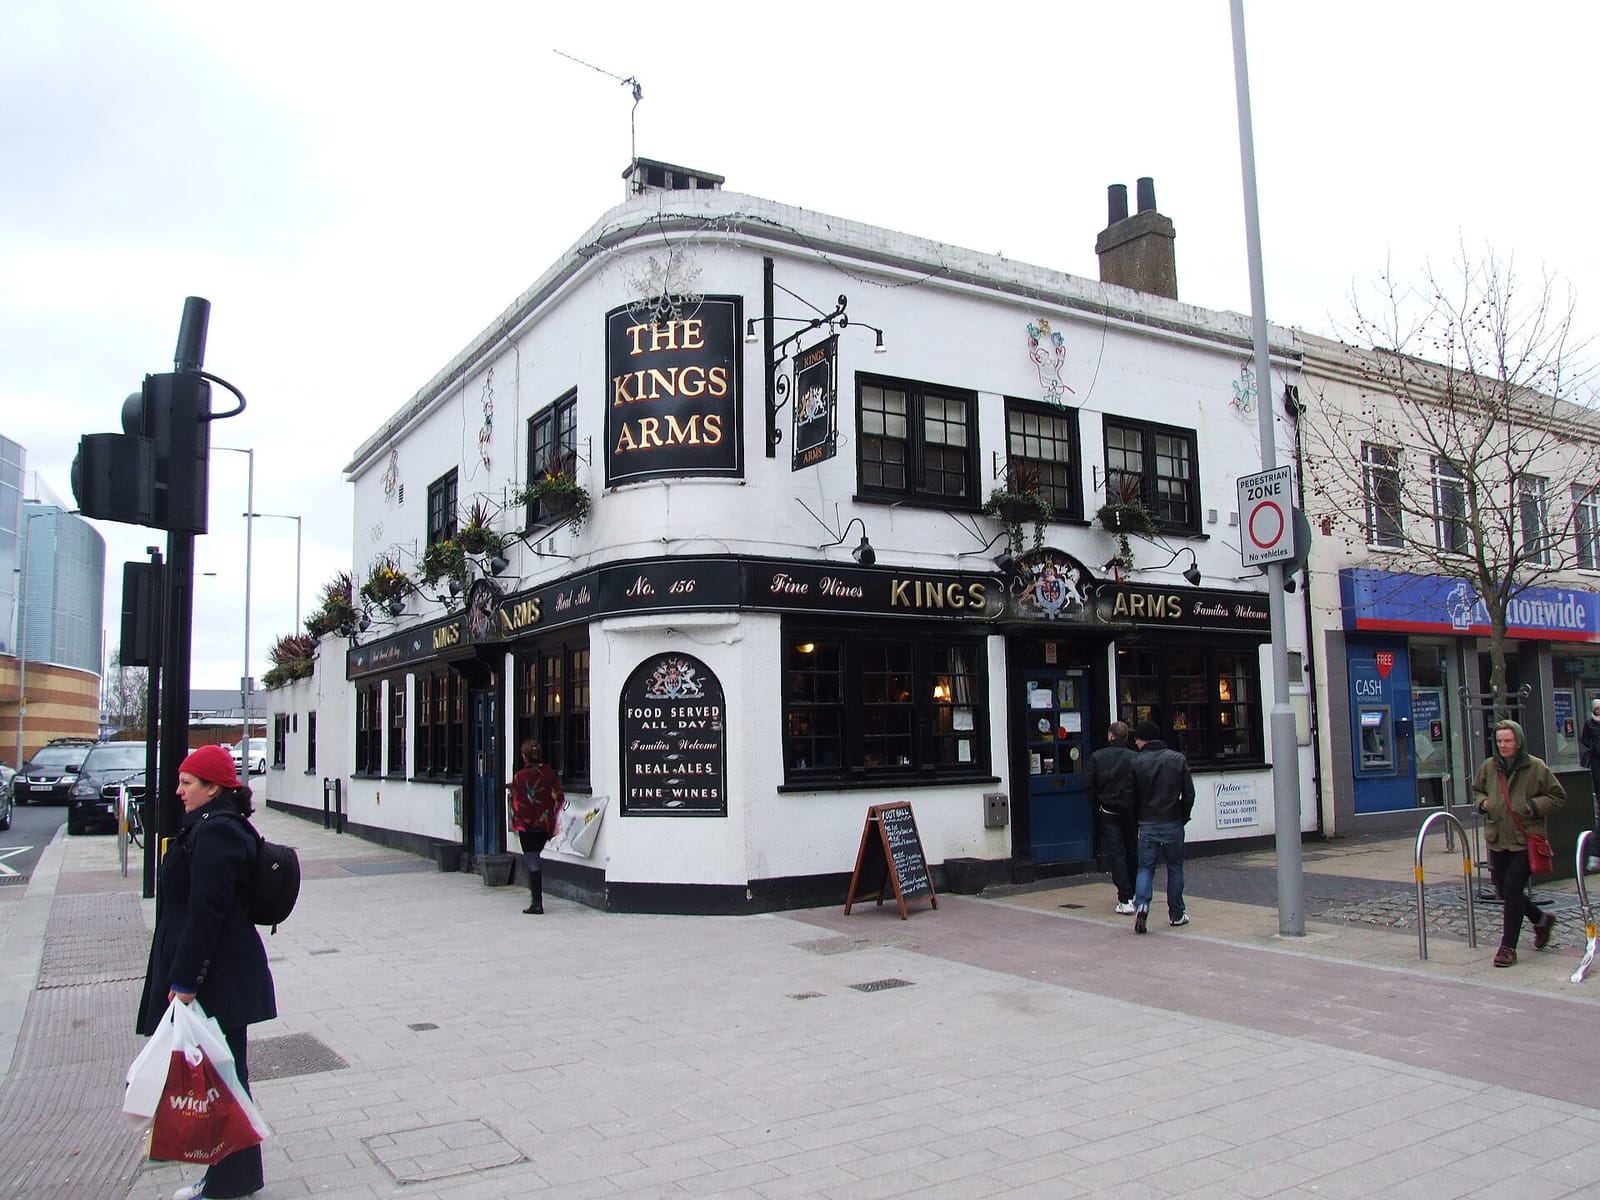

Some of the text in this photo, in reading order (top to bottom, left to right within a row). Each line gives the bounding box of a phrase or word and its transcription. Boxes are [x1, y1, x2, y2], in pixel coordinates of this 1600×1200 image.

[627, 319, 705, 355] THE
[804, 349, 825, 368] KINGS
[613, 366, 728, 408] KINGS
[615, 415, 723, 454] ARMS
[803, 447, 823, 464] ARMS
[1240, 471, 1288, 488] PEDESTRIAN
[1247, 482, 1281, 501] ZONE
[1249, 548, 1288, 561] No vehicles
[626, 575, 696, 597] No. 156
[771, 573, 863, 598] Fine Wines
[891, 579, 986, 610] KINGS
[1112, 591, 1183, 619] ARMS
[1193, 601, 1268, 619] Families Welcome
[500, 598, 542, 631] ARMS
[433, 622, 460, 650] KINGS
[1376, 654, 1392, 665] FREE
[1355, 680, 1382, 696] CASH
[628, 706, 719, 718] FOOD SERVED
[641, 720, 706, 729] ALL DAY
[630, 739, 718, 751] Families Welcome
[635, 763, 713, 774] REAL ALES
[631, 788, 718, 798] FINE WINES
